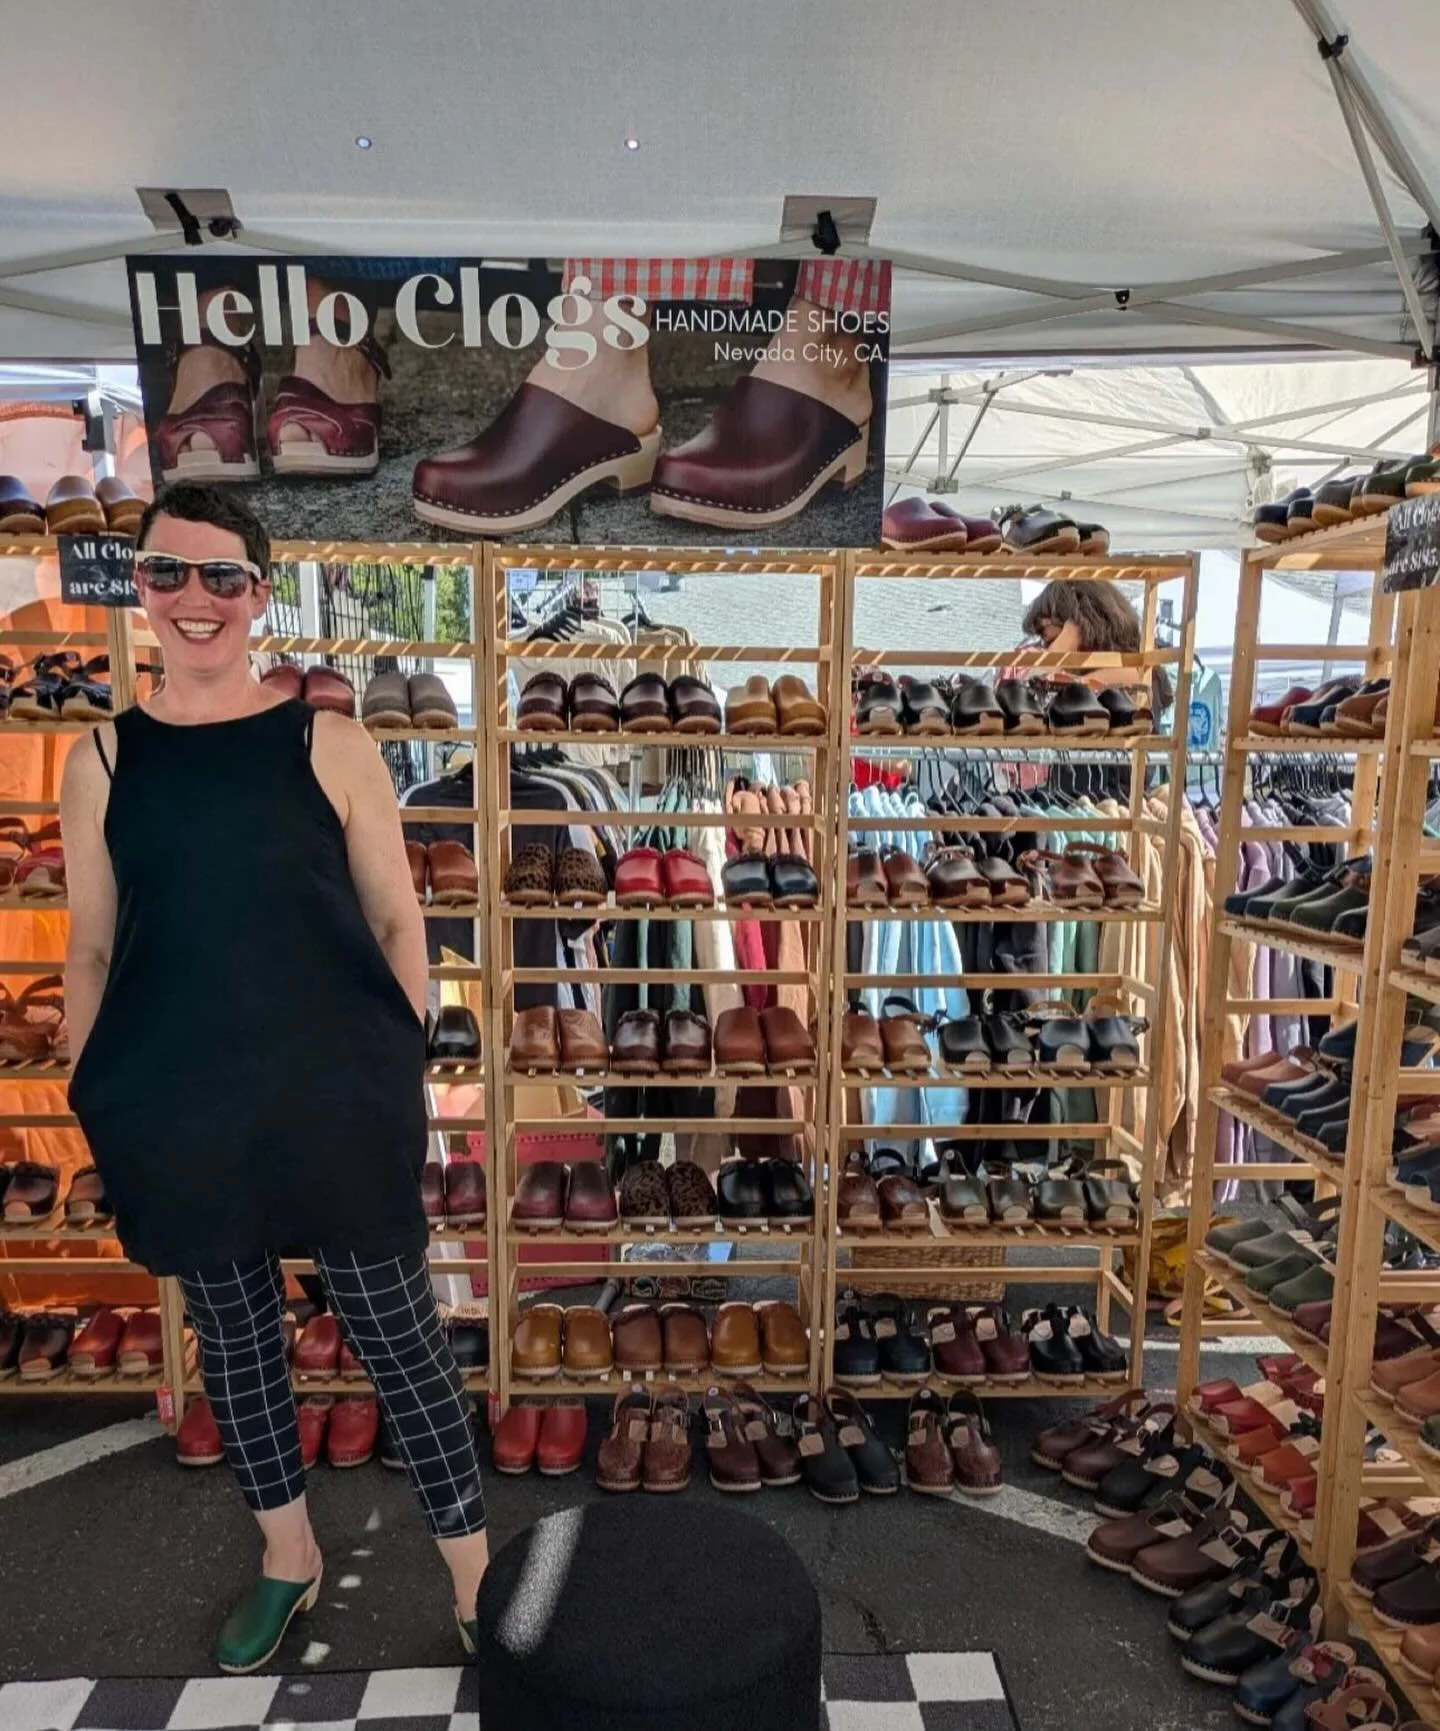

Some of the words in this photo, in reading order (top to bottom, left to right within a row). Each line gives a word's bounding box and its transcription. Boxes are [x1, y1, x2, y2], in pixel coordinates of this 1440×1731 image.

[136, 264, 369, 347] Hello
[395, 267, 650, 370] Clogs
[656, 309, 798, 333] HANDMADE
[807, 310, 890, 334] SHOES
[714, 342, 795, 361] Nevada
[802, 342, 848, 368] City,
[854, 343, 887, 362] CA.
[69, 542, 96, 560] All
[101, 541, 133, 560] Clo
[69, 581, 105, 595] are
